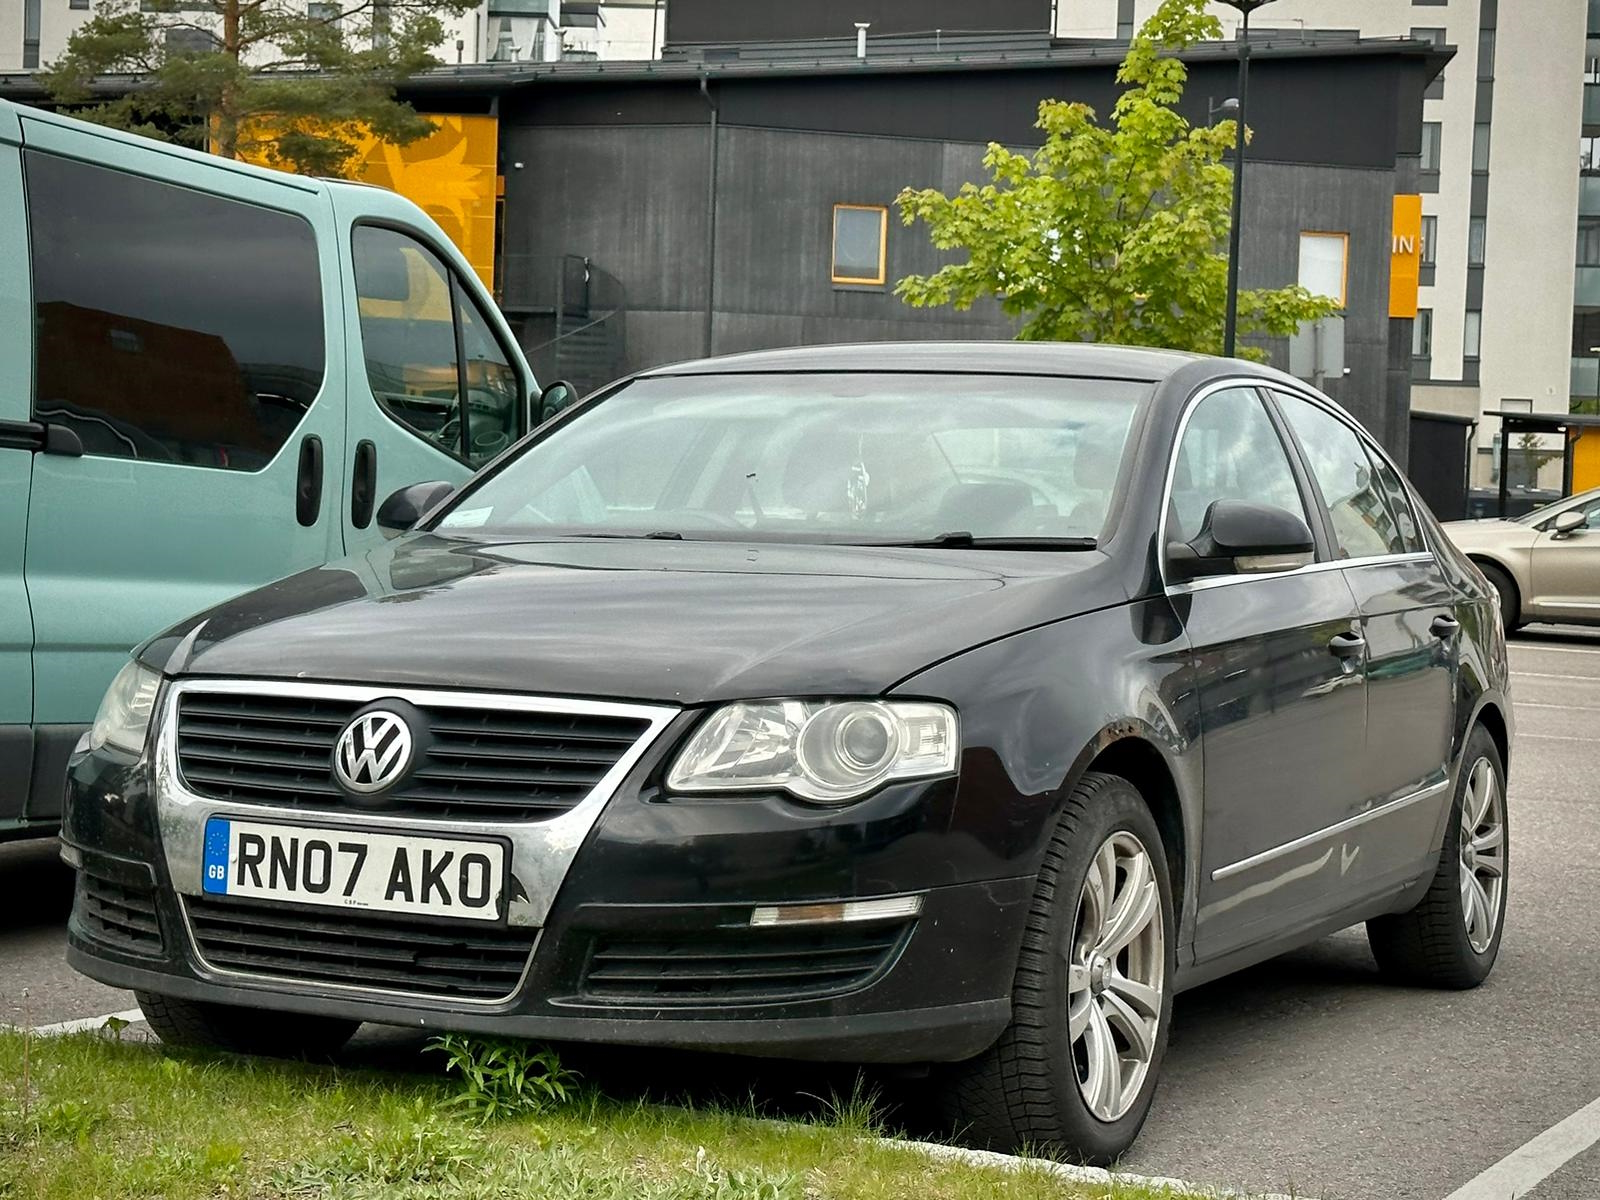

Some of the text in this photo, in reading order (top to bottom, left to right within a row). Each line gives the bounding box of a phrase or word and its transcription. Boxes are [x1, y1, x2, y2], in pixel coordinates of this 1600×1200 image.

[335, 711, 412, 792] VW
[208, 864, 225, 880] GB
[237, 833, 491, 908] RN07 AKO
